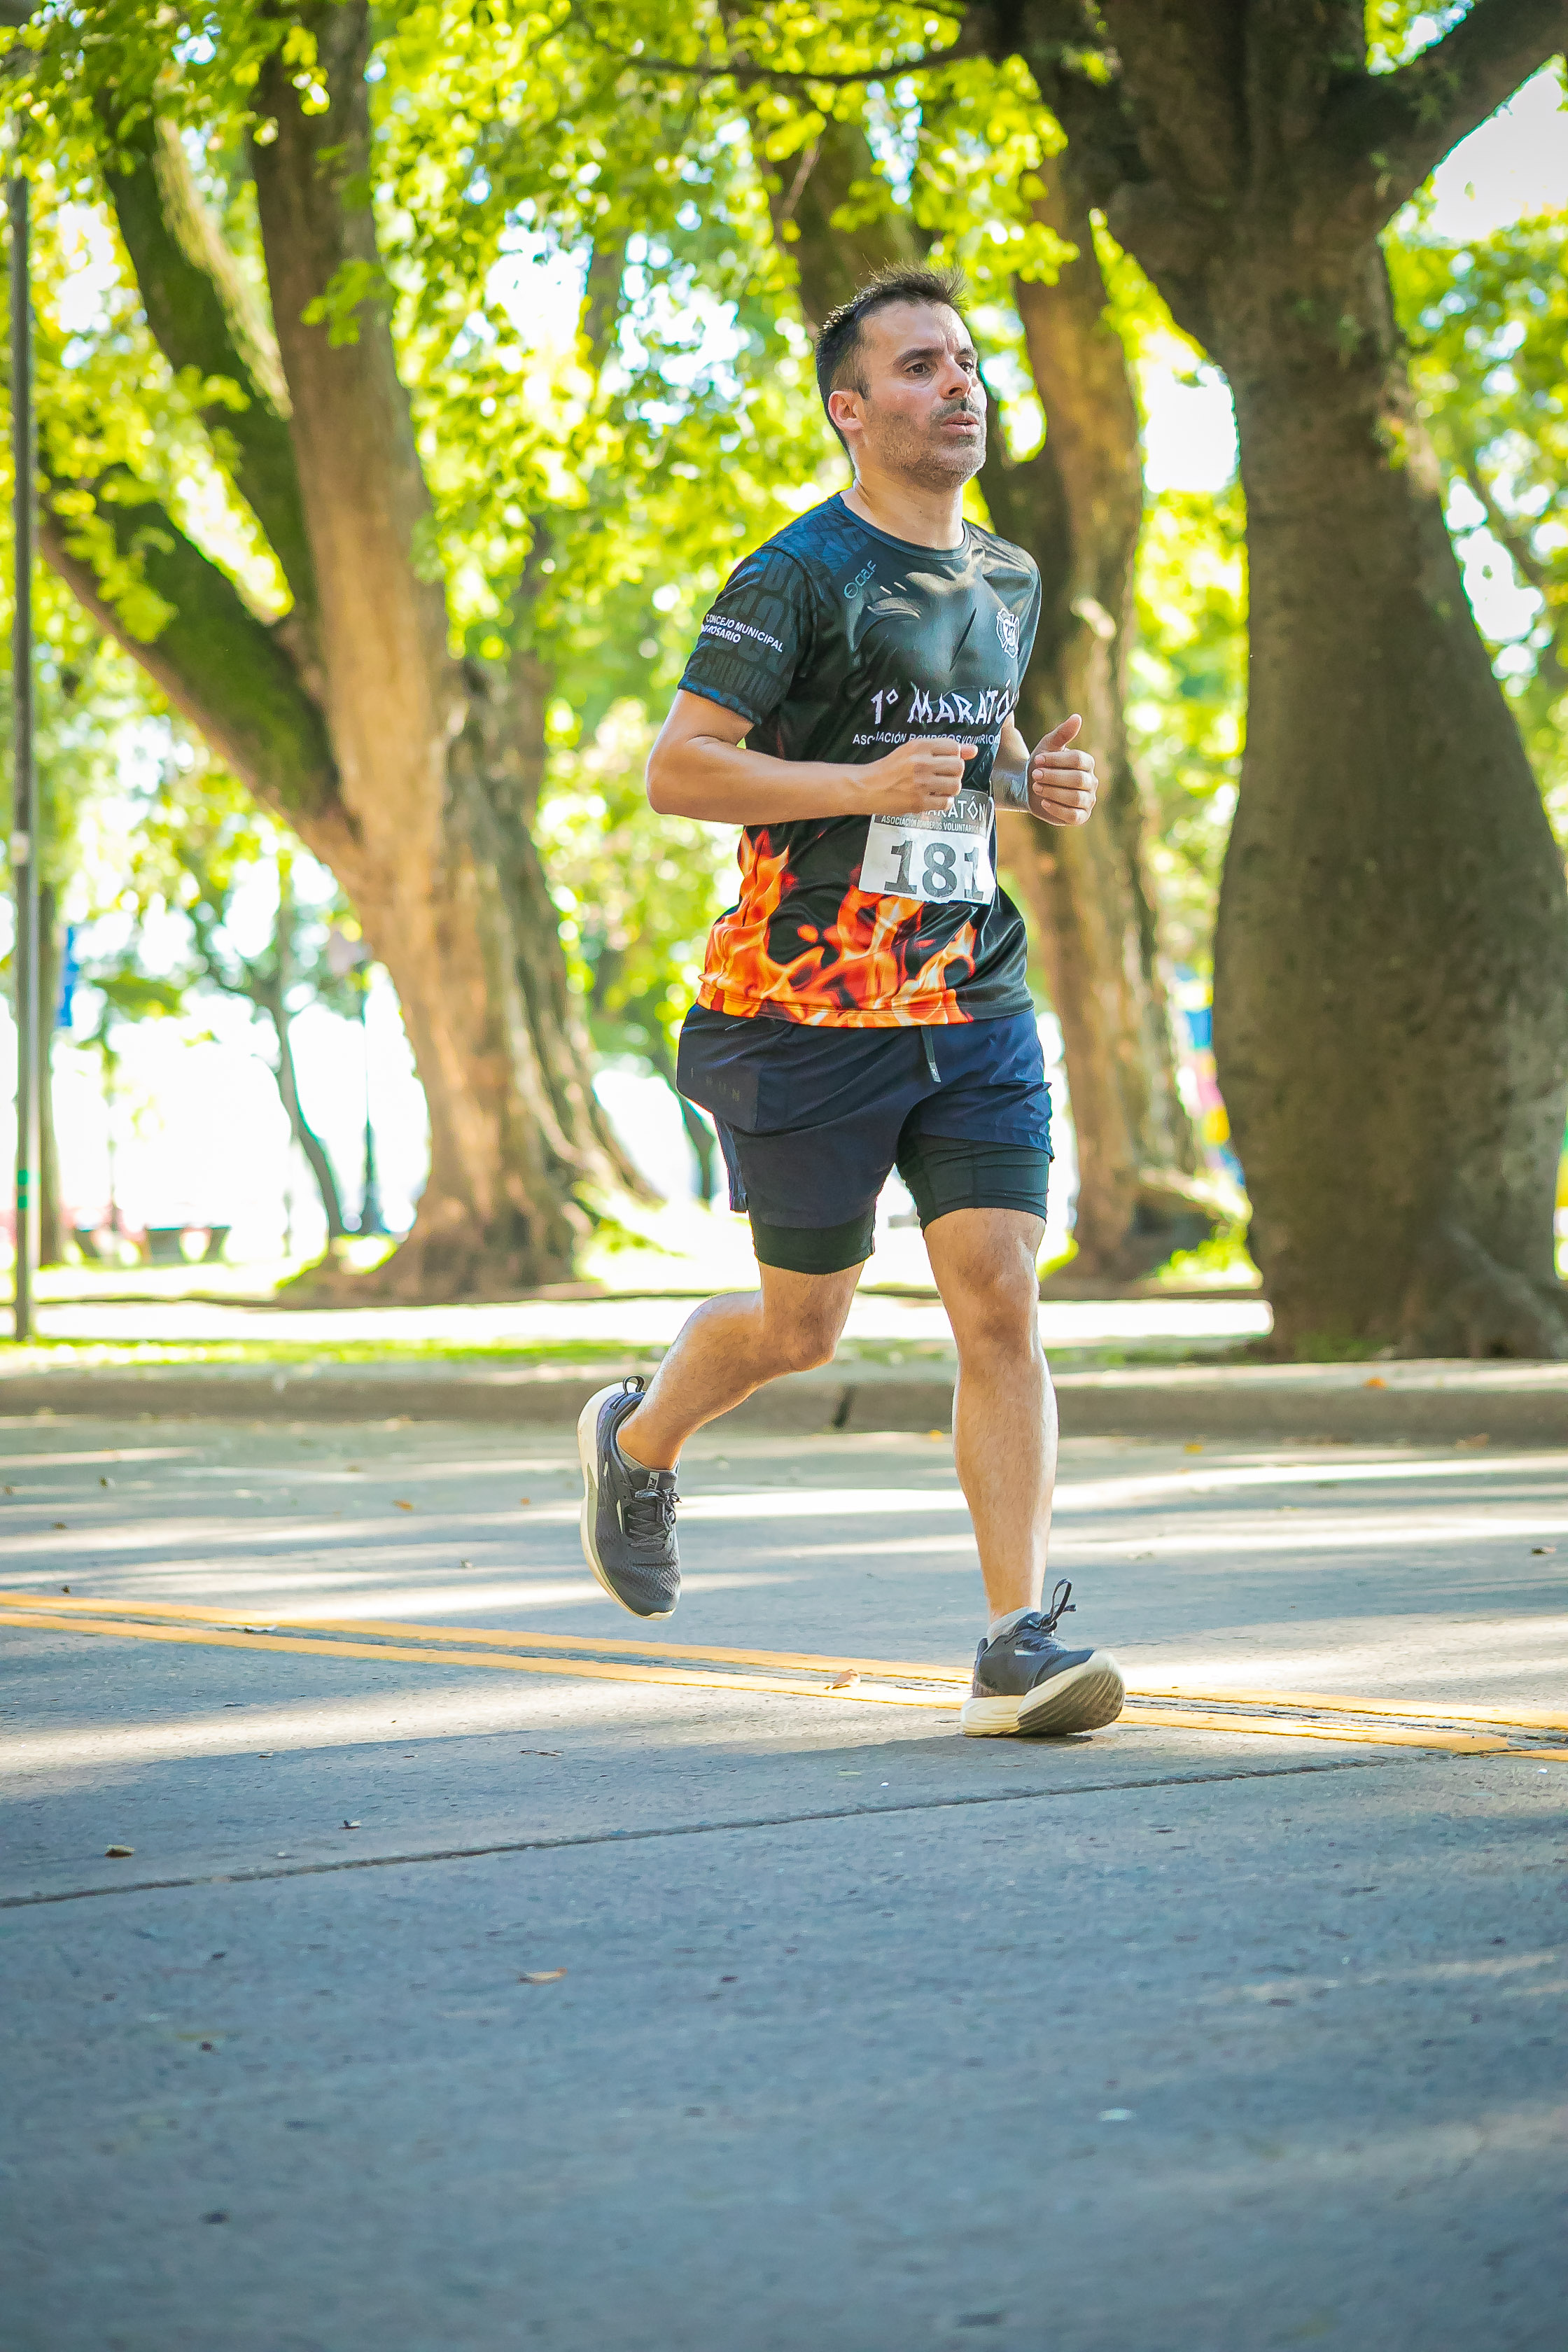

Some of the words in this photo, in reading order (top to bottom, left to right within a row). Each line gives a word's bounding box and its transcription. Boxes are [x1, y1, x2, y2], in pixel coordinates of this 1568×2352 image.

[706, 613, 735, 629] CONCEJO
[734, 622, 783, 652] MUNICIPAL
[852, 731, 907, 746] ASIACIÓN
[925, 794, 986, 822] ATÓN
[884, 839, 984, 901] 181
[648, 1476, 658, 1490] FIL
